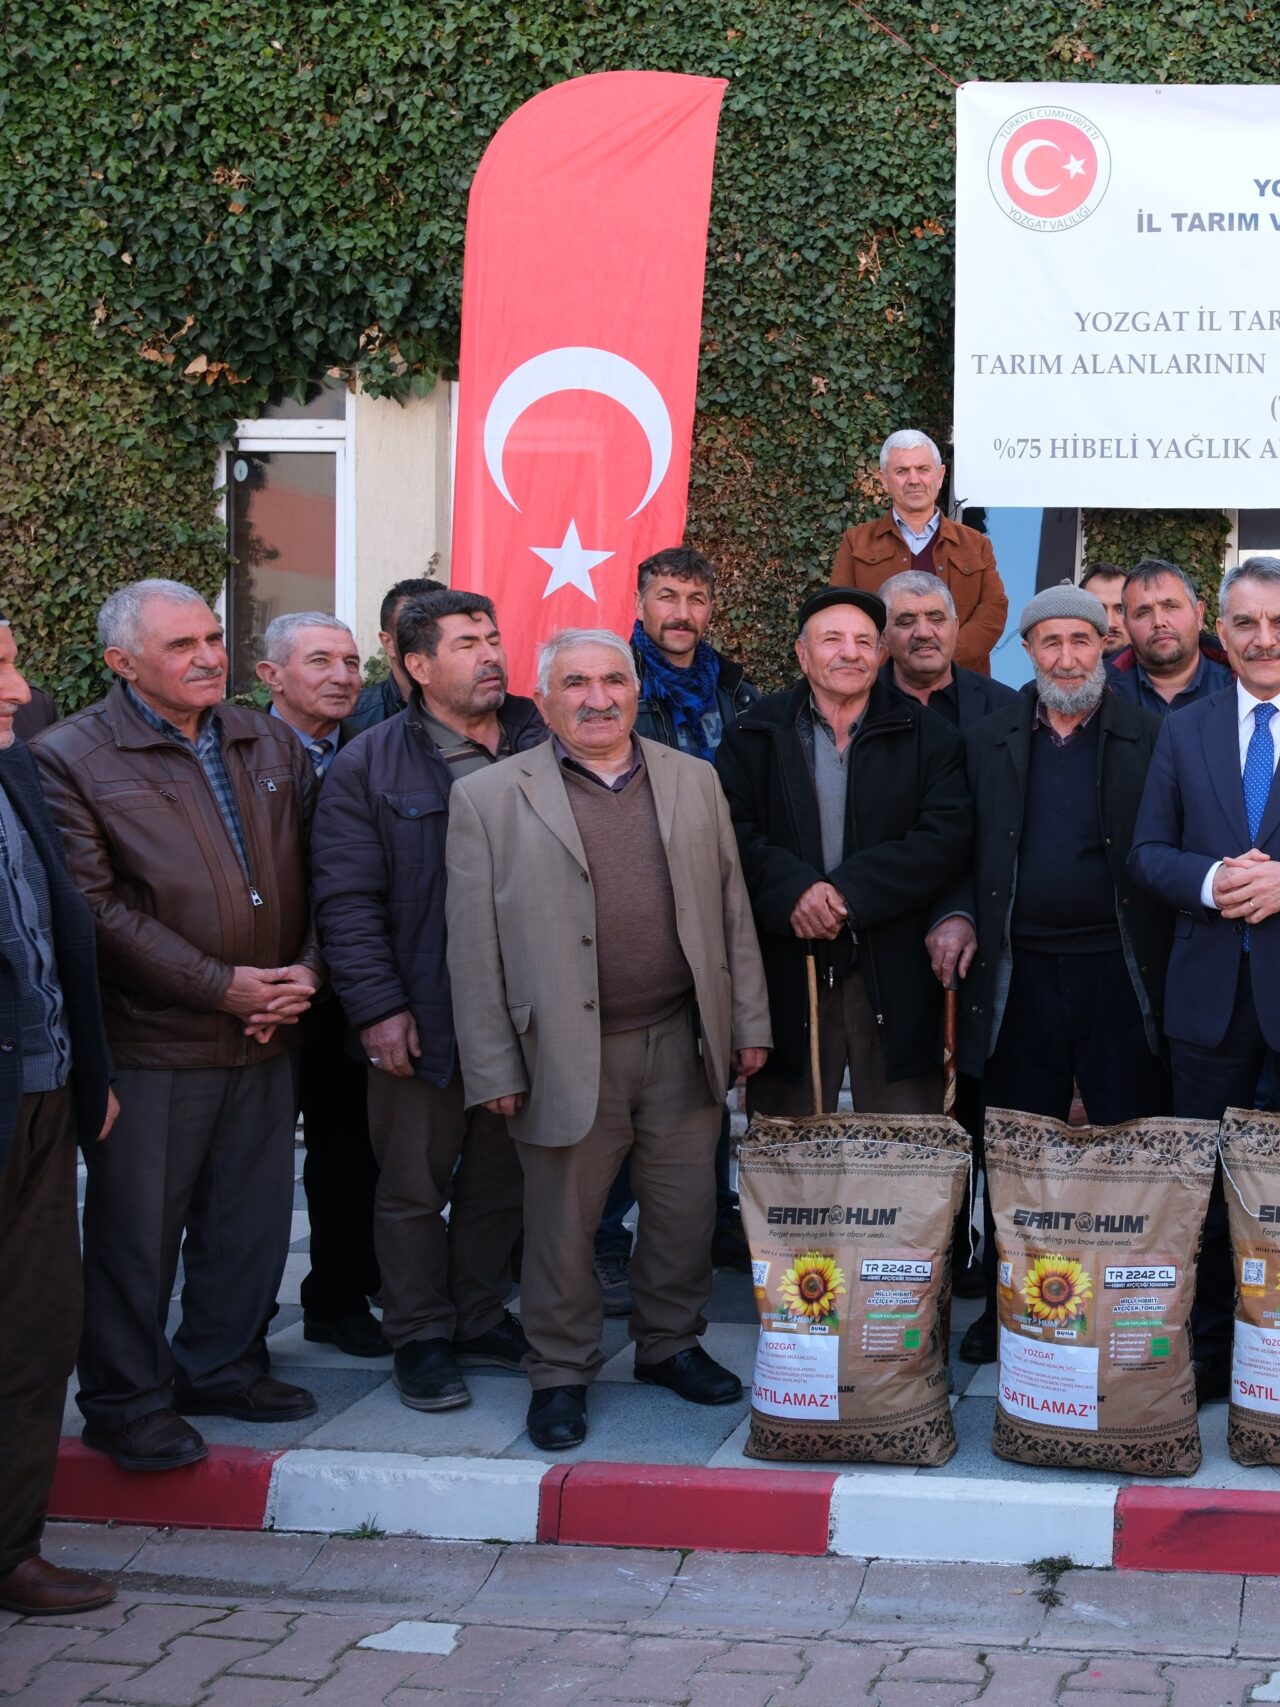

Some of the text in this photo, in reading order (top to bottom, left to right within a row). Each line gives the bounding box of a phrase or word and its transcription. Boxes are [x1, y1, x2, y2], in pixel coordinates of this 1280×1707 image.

[1000, 109, 1100, 140] TÜRKİYE CUMHURİYETİ
[1009, 206, 1048, 229] YOZGAT
[1136, 209, 1162, 233] İL
[1170, 212, 1259, 233] TARIM
[1074, 311, 1189, 332] YOZGAT
[1197, 305, 1222, 331] İL
[971, 353, 1063, 375] TARIM
[1071, 353, 1266, 375] ALANLARININ
[993, 438, 1041, 459] %75
[1049, 433, 1139, 459] HİBELİ
[1146, 433, 1252, 459] YAĞLIK
[865, 1263, 928, 1274] TR 2242 CL
[1108, 1270, 1173, 1280] TR 2242 CL
[765, 1342, 796, 1350] YOZGAT
[1024, 1348, 1055, 1360] YOZGAT
